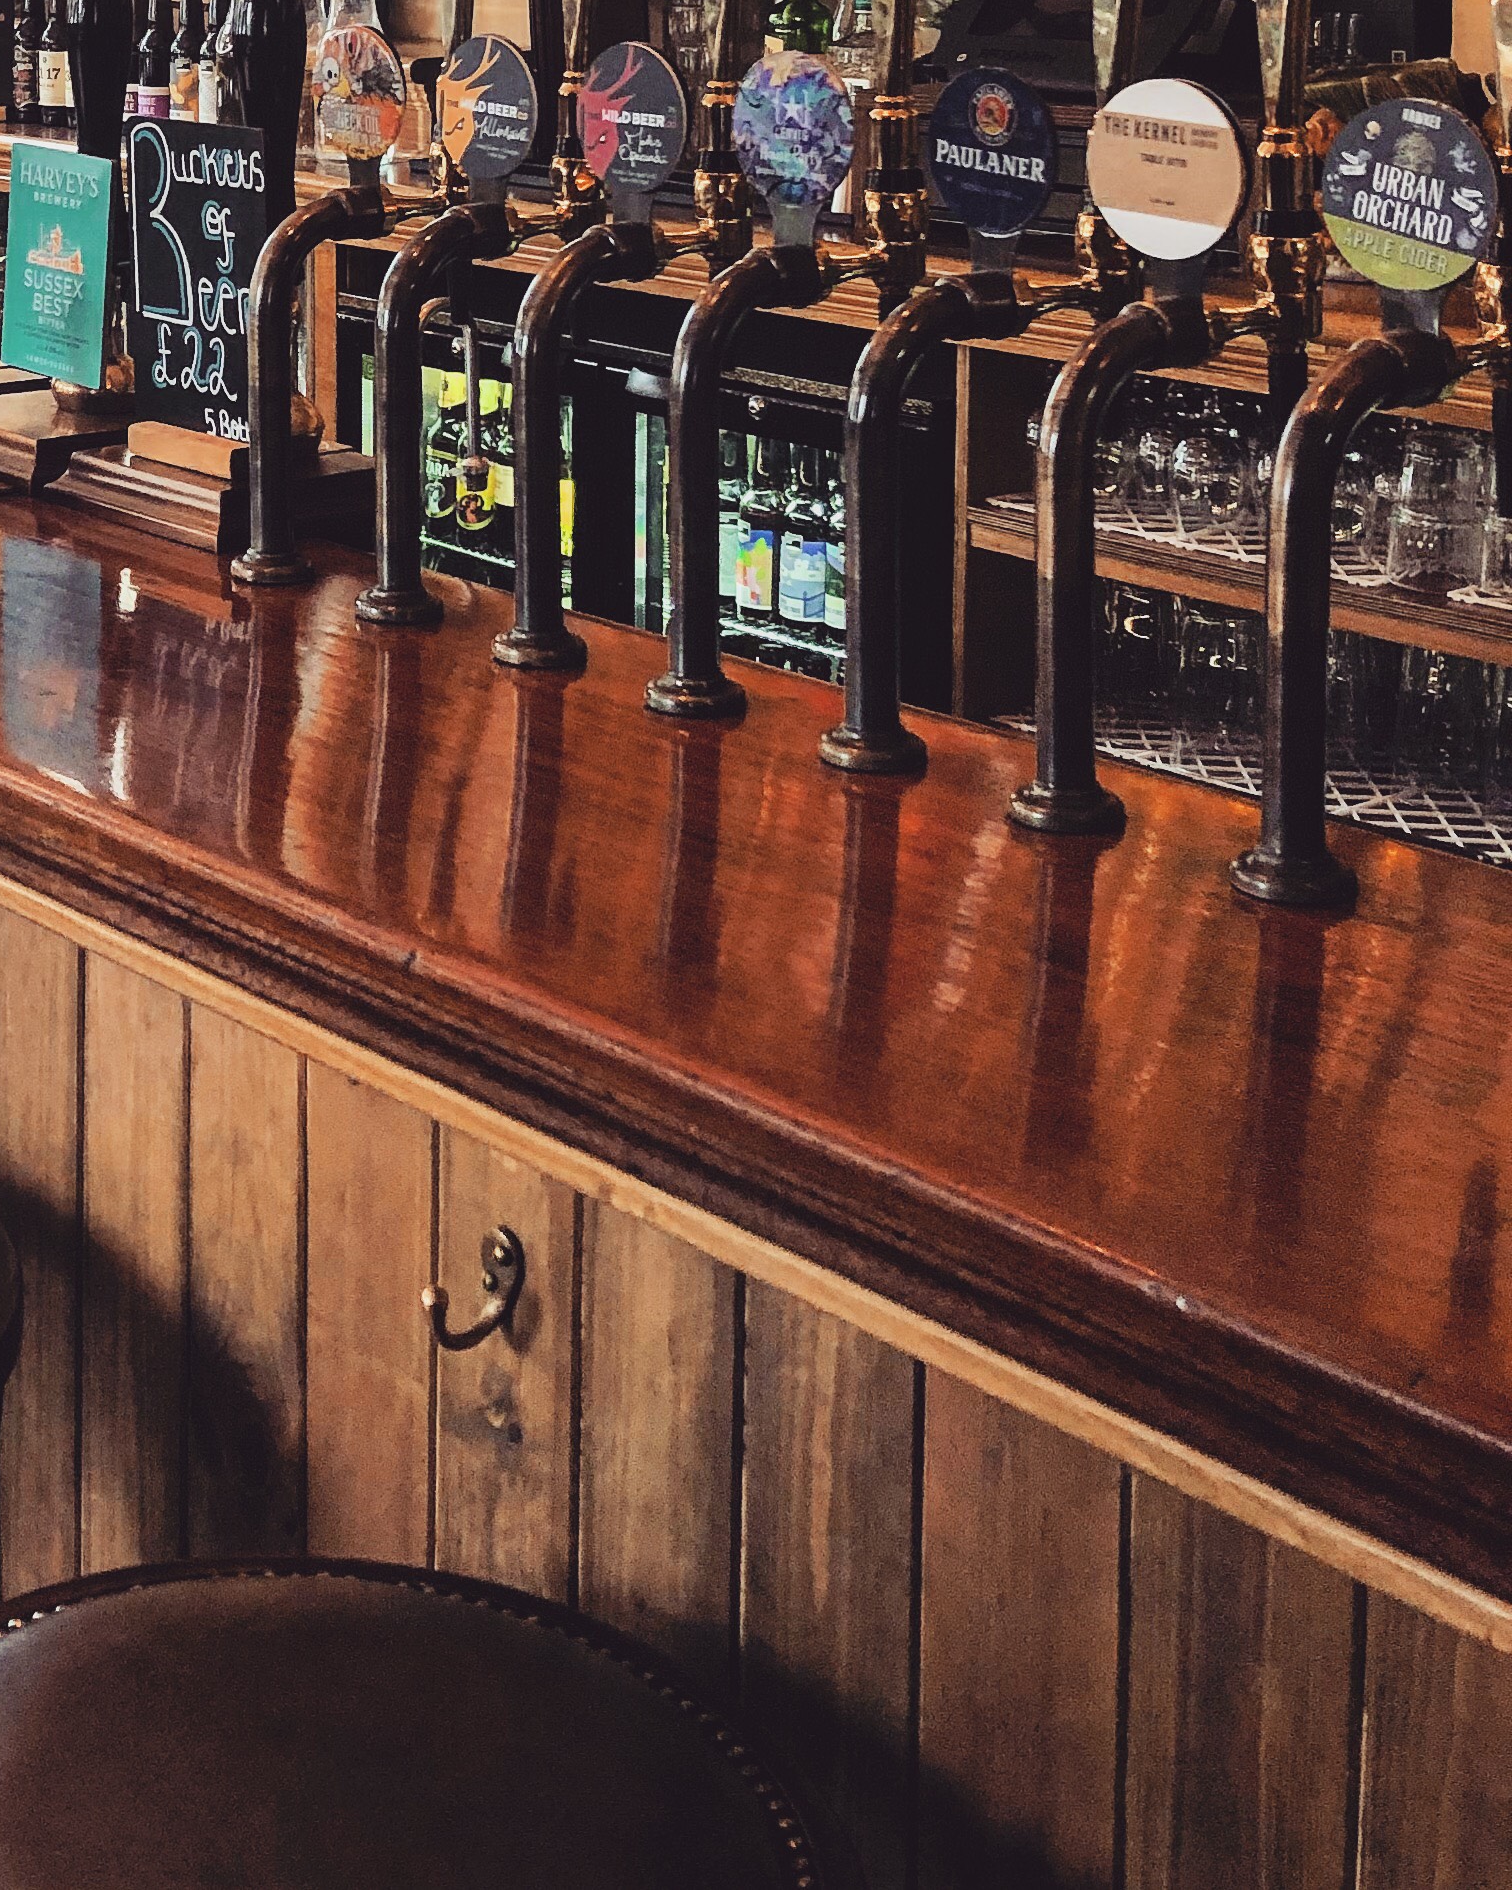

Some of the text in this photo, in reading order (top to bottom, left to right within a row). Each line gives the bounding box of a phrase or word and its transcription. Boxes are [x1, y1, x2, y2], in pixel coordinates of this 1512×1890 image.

[487, 103, 518, 120] BEER
[632, 112, 666, 128] BEER
[1104, 115, 1130, 137] THE
[1133, 119, 1187, 146] KERNEL
[935, 138, 1046, 183] PAULANER
[20, 161, 100, 199] HARVEY'S
[1371, 162, 1446, 210] URBAN
[33, 191, 84, 210] BREWERY
[1352, 190, 1454, 246] ORCHARD
[1342, 226, 1451, 278] APPLE CIDER
[23, 268, 86, 301] SUSSEX
[32, 292, 74, 318] BEST
[152, 321, 238, 402] £22
[204, 407, 217, 437] 5
